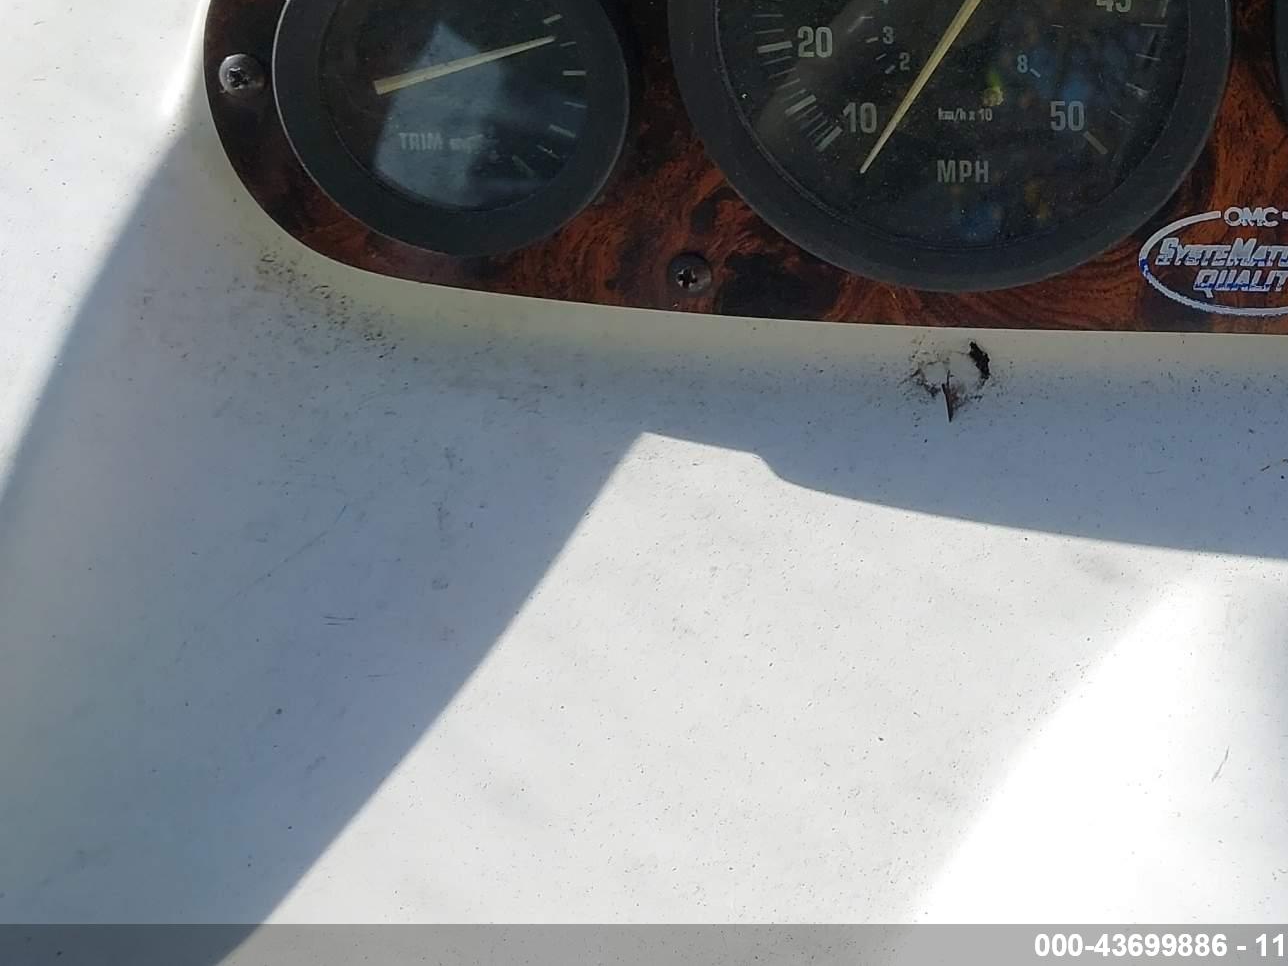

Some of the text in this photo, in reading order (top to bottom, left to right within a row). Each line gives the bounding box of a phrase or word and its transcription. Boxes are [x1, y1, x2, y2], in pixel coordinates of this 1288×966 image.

[797, 27, 833, 58] 20
[843, 102, 878, 133] 10
[977, 107, 993, 122] 10
[1050, 101, 1085, 131] 50
[936, 160, 990, 183] MPH
[1224, 206, 1279, 227] OMC
